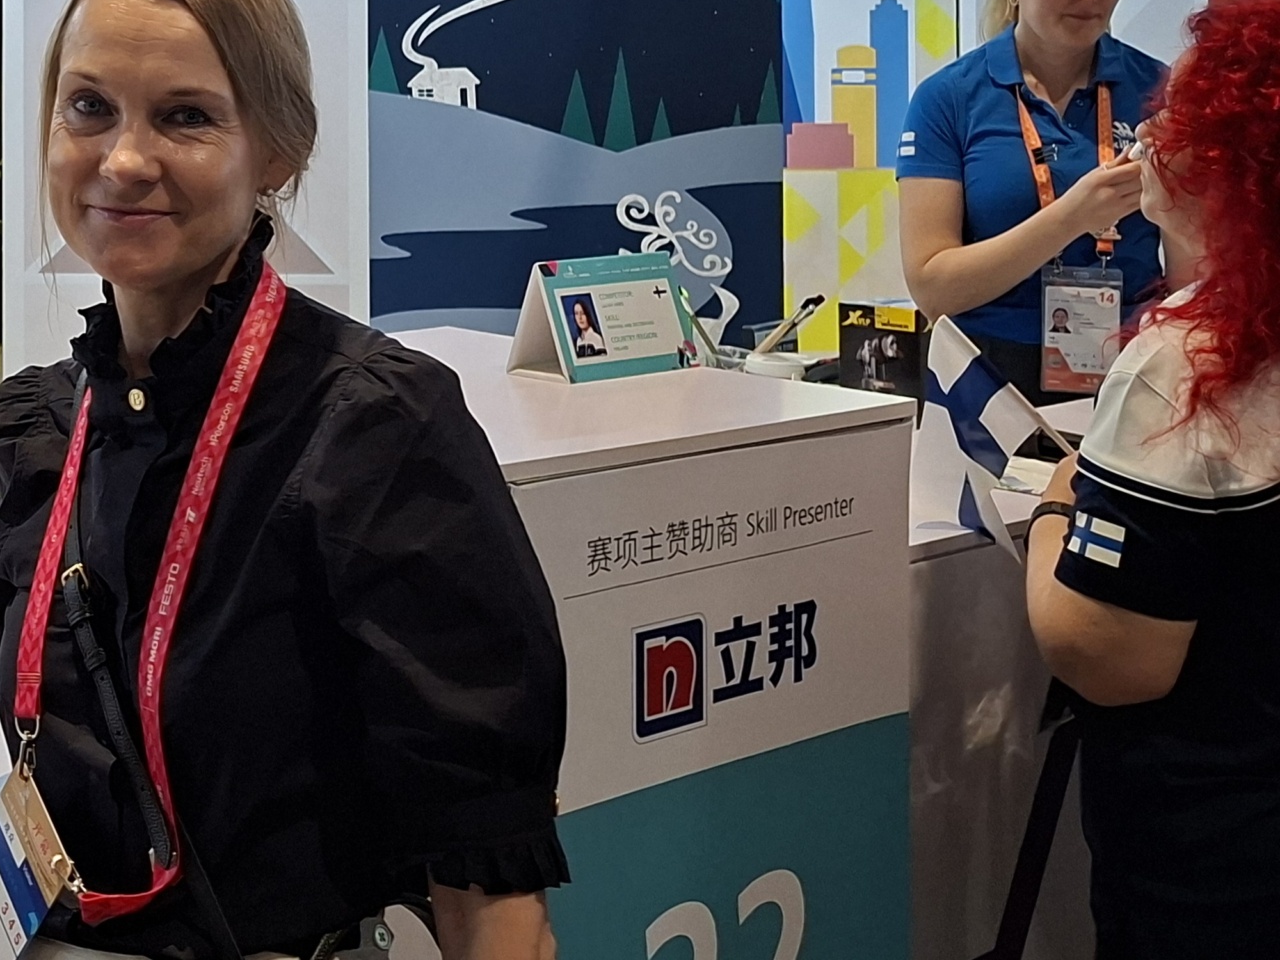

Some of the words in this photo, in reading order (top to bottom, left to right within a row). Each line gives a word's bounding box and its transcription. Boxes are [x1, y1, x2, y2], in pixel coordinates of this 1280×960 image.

[1099, 291, 1115, 304] 14
[229, 344, 256, 393] SAMSUNG
[586, 511, 739, 578] 赛项主赞助商
[746, 505, 778, 537] Skill
[783, 495, 855, 530] Presenter
[159, 562, 180, 616] FESTO
[150, 626, 163, 663] MORI
[711, 598, 819, 704] 立邦
